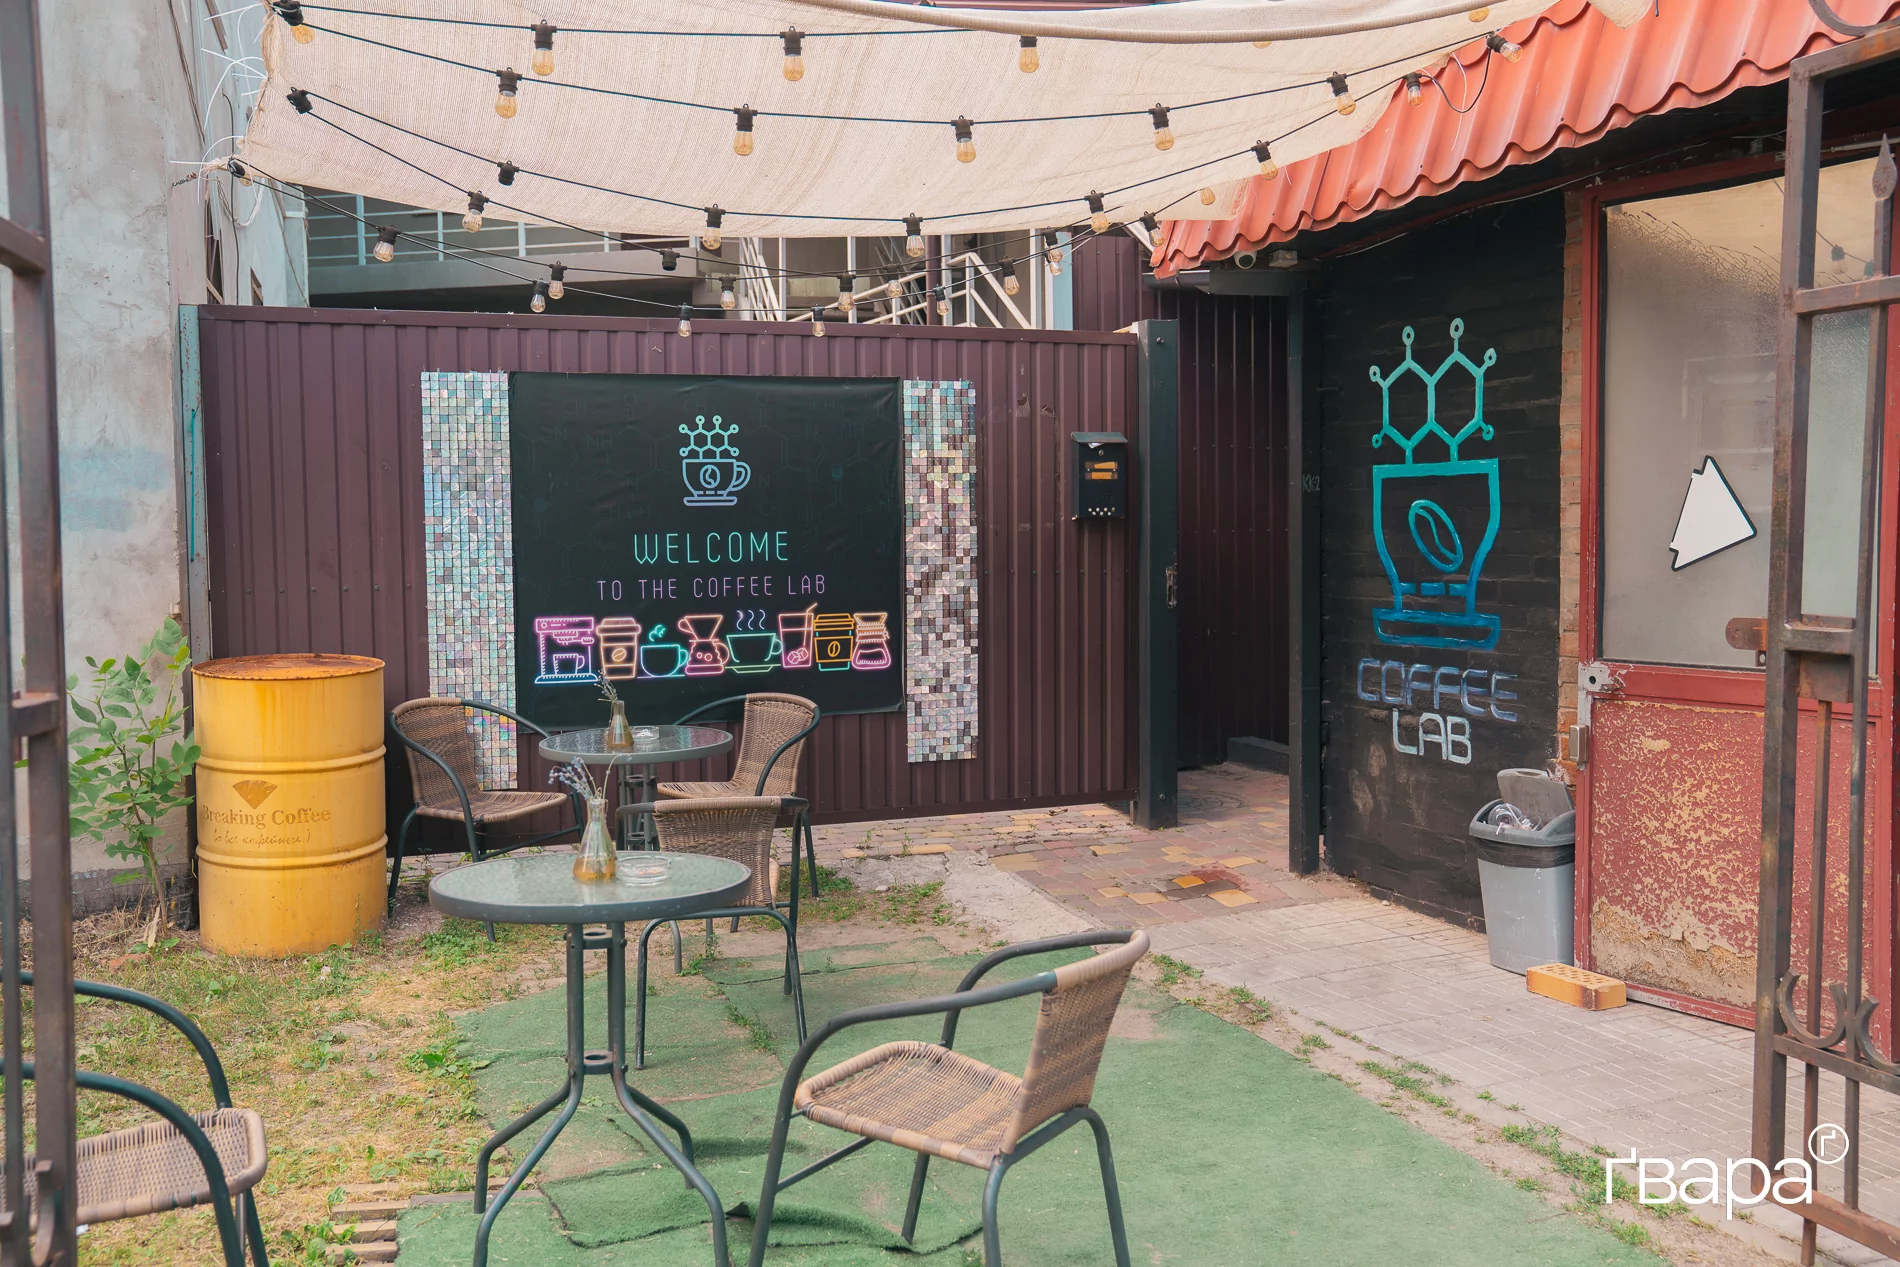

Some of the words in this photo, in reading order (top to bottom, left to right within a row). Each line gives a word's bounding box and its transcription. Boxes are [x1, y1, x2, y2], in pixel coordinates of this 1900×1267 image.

[634, 531, 788, 565] WELCOME
[597, 580, 622, 601] TO
[638, 578, 677, 600] THE
[693, 576, 773, 598] COFFEE
[788, 574, 826, 595] LAB
[1357, 657, 1518, 722] COFFEE
[1392, 707, 1472, 765] LAB
[202, 804, 267, 830] Breaking
[271, 807, 332, 826] Coffee
